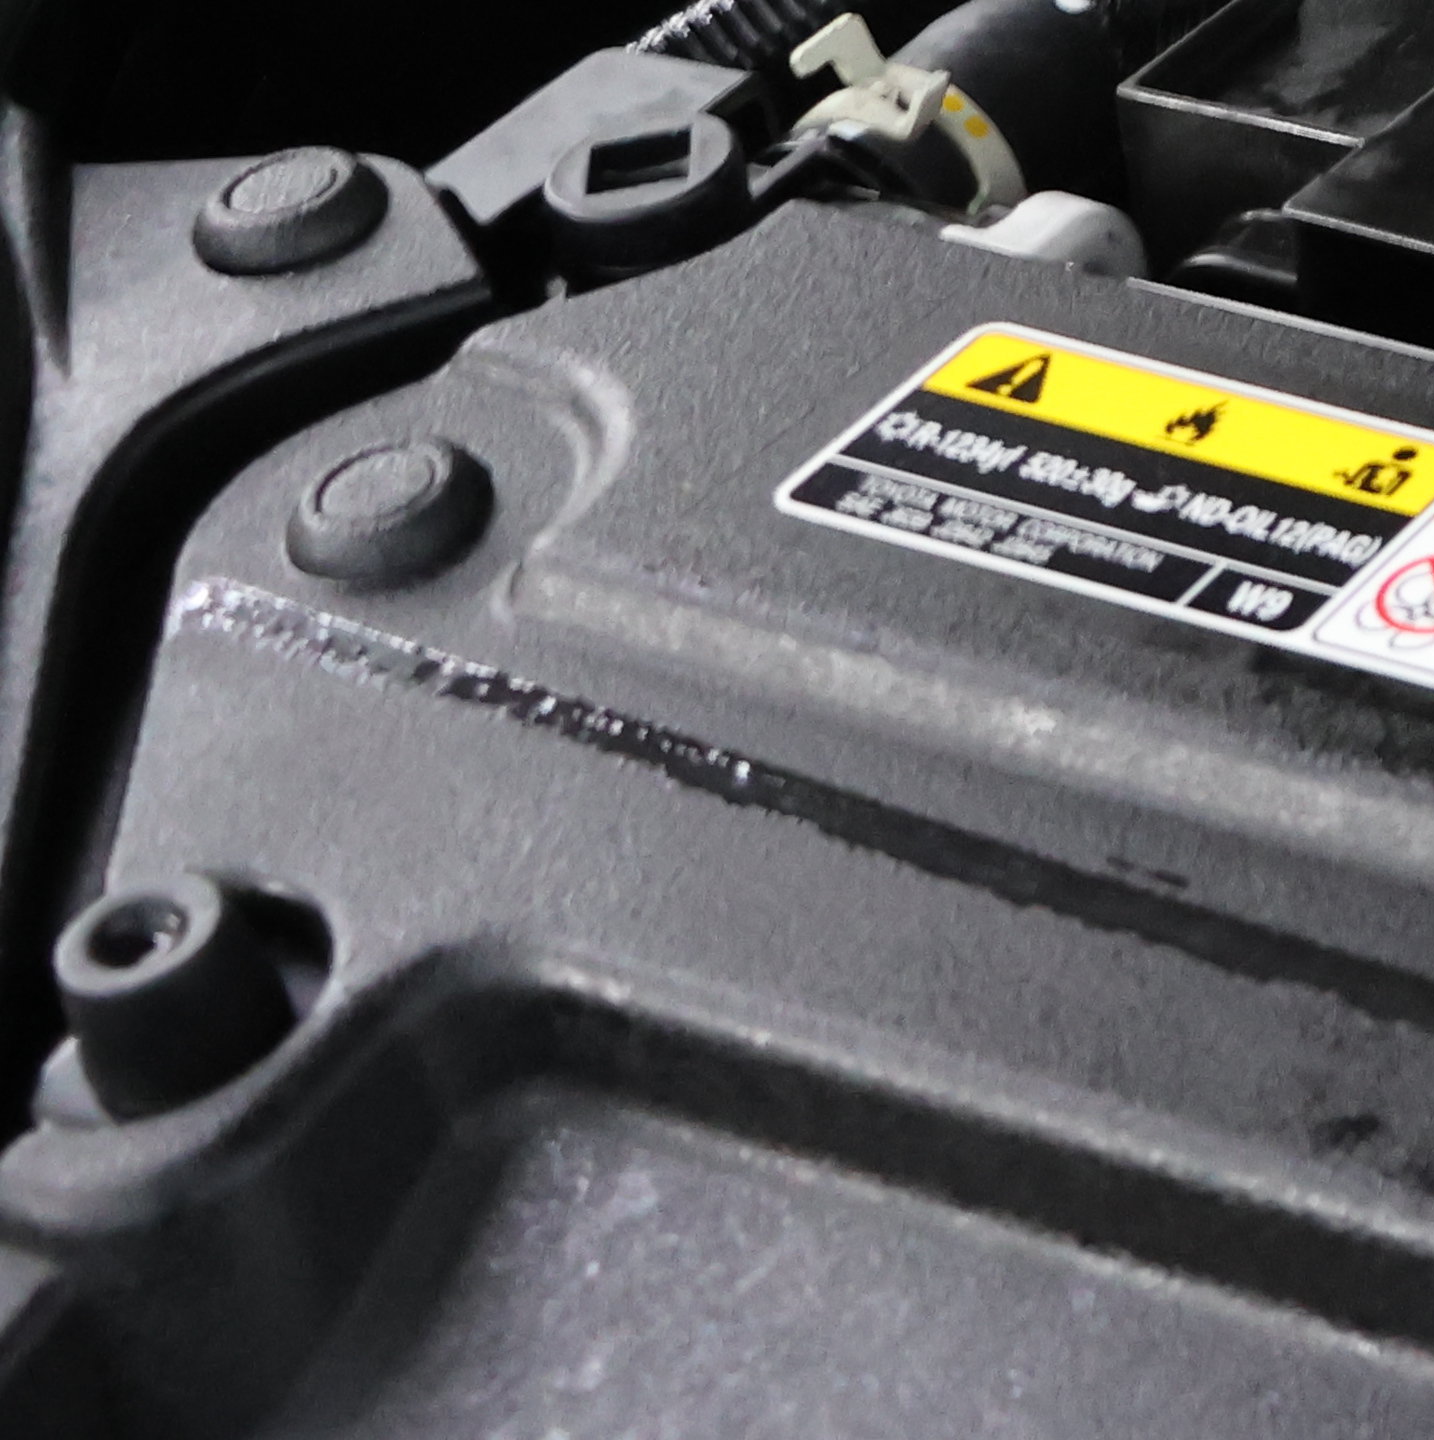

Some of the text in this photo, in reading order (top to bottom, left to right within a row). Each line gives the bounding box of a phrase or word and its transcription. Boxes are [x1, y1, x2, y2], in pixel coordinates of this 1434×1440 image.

[859, 474, 1165, 573] TOYOTA MOTOR CORPORATION
[1227, 580, 1293, 621] W9
